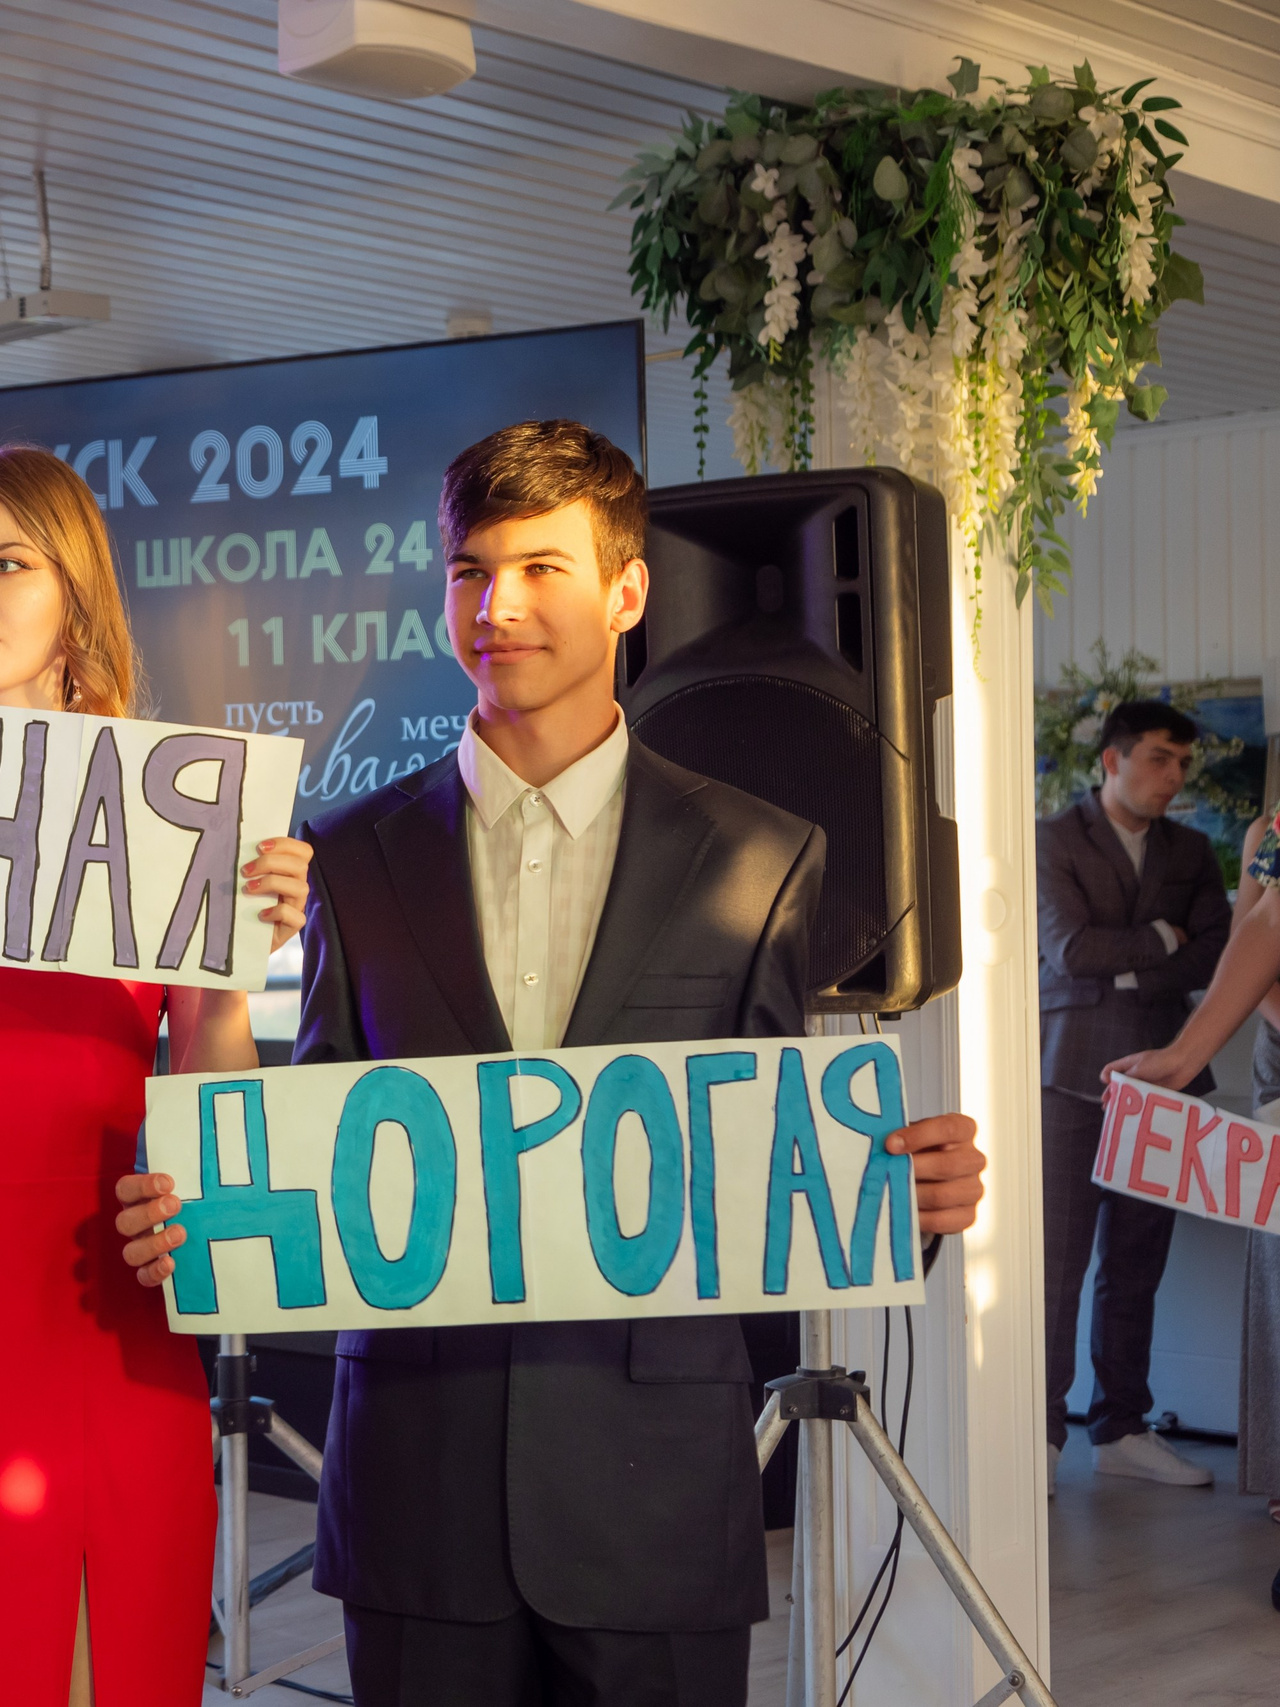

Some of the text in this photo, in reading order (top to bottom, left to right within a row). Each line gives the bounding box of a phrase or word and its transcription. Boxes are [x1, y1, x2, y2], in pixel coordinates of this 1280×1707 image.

[189, 415, 388, 504] 2024
[136, 519, 433, 588] ШКОЛА 24
[228, 608, 456, 667] 11 КЛАС
[224, 700, 468, 741] пусть меч
[165, 1041, 915, 1315] ДОРОГАЯ
